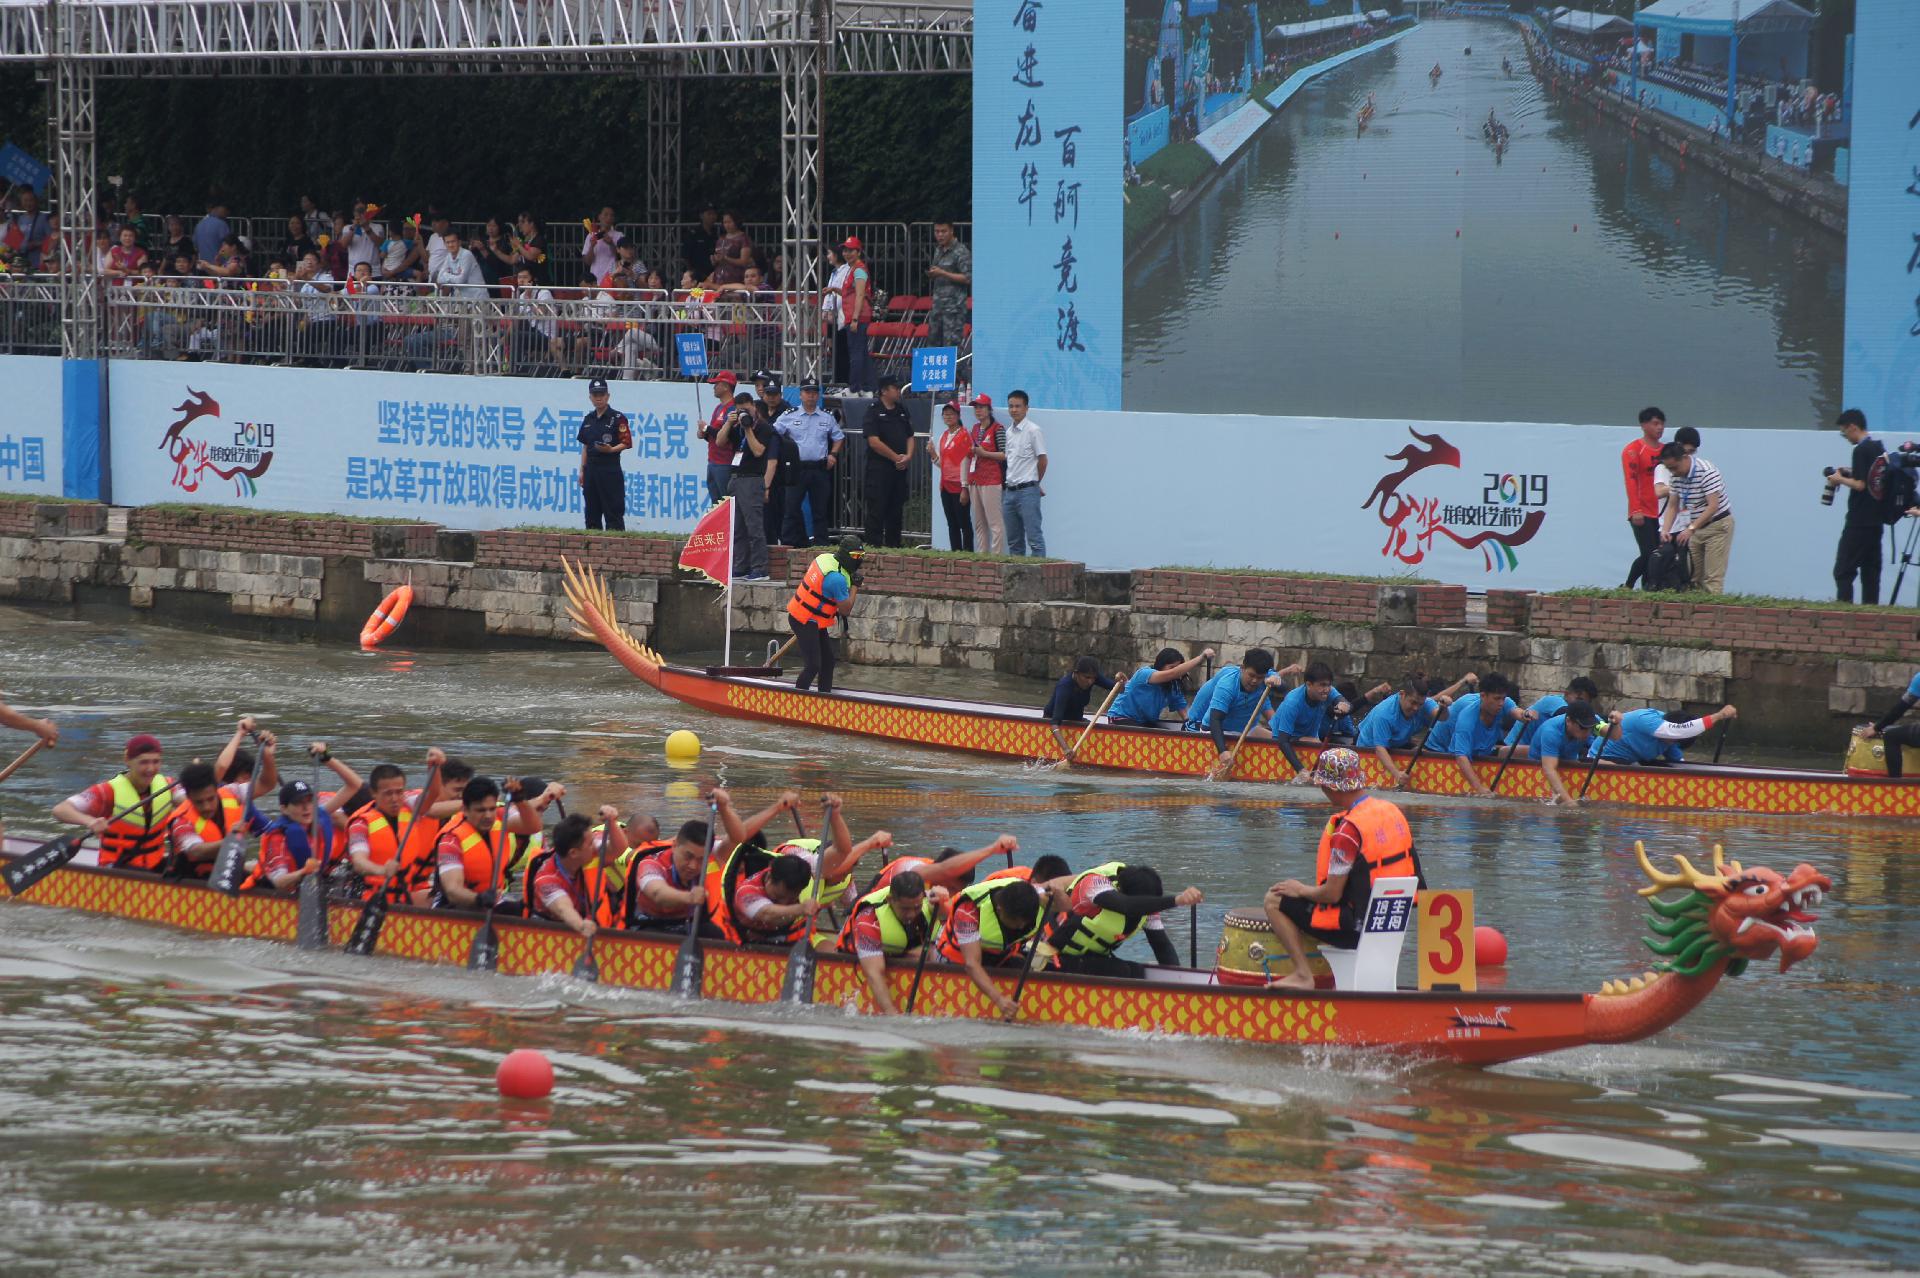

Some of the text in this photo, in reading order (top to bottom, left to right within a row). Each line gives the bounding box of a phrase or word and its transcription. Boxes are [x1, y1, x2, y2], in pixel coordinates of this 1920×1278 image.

[234, 421, 275, 448] 2019
[377, 400, 689, 459] 坚持党的领导 全面治党
[0, 434, 45, 482] 中国
[1483, 472, 1548, 506] 2019
[1442, 504, 1523, 528] 龙舟文化艺术节
[1428, 893, 1464, 975] 3
